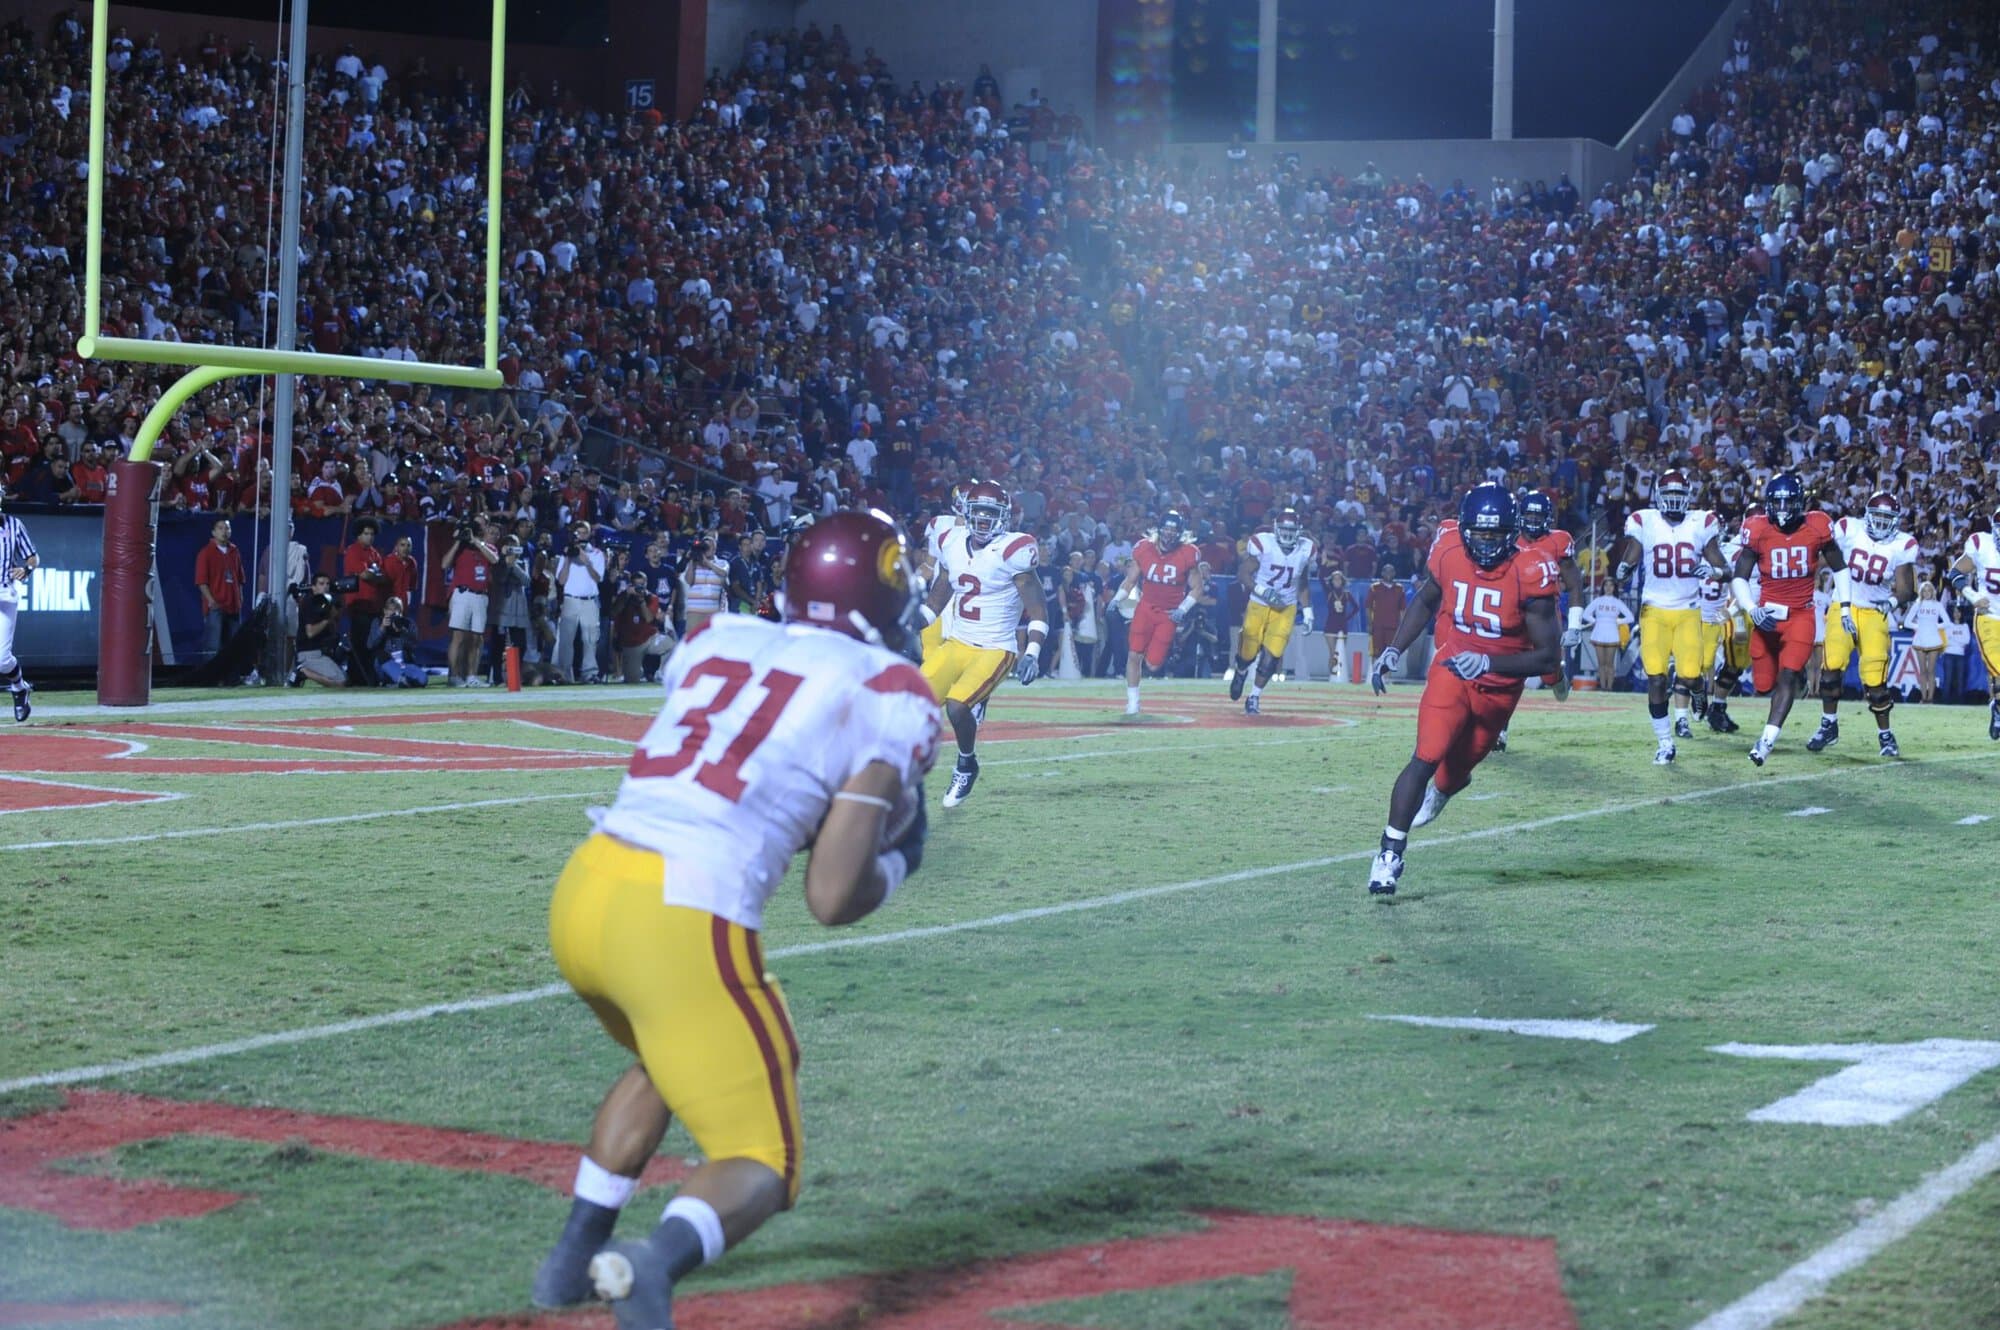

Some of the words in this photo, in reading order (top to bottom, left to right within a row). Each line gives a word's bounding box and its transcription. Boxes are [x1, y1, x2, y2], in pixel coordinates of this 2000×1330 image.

[627, 85, 652, 106] 15
[1929, 248, 1953, 272] 31
[106, 473, 118, 489] R
[1029, 547, 1038, 567] 2
[1653, 542, 1695, 579] 86
[1771, 546, 1808, 579] 83
[1848, 548, 1889, 586] 68
[32, 568, 91, 611] MILK
[1266, 564, 1295, 589] 71
[958, 573, 981, 621] 2
[1453, 580, 1502, 638] 15
[629, 657, 806, 803] 31
